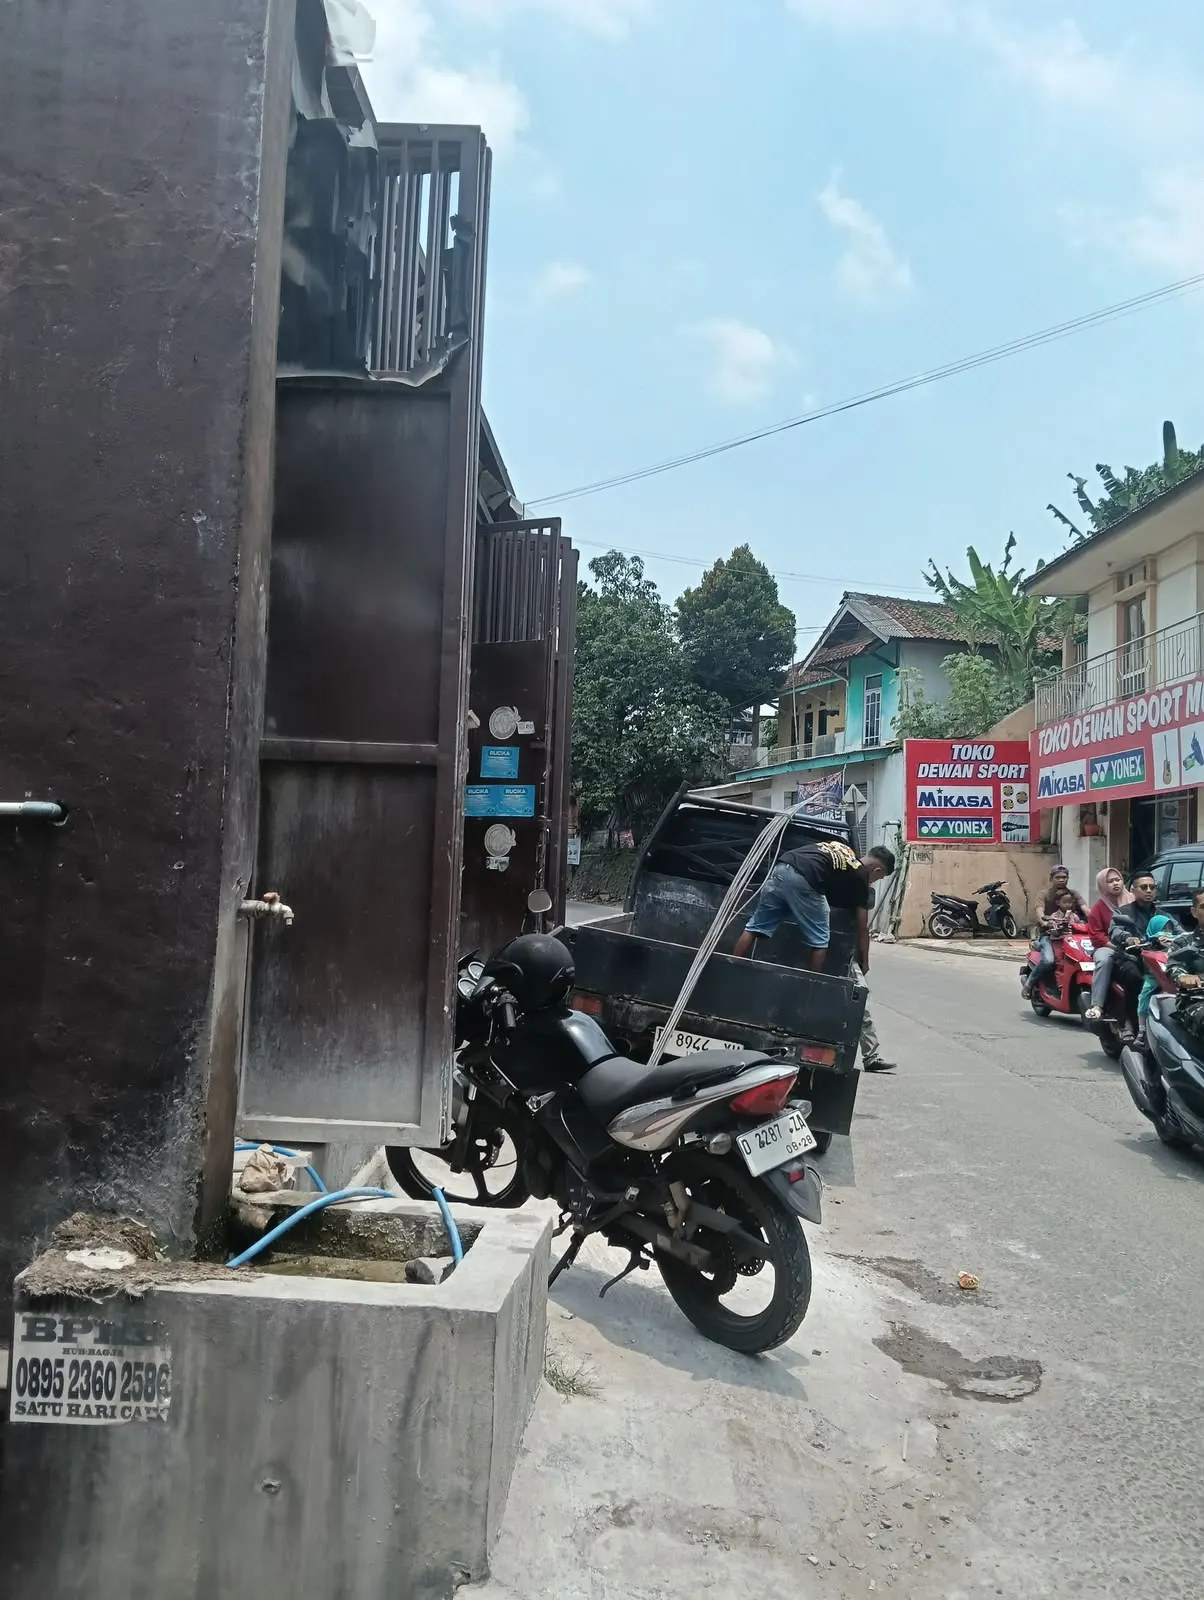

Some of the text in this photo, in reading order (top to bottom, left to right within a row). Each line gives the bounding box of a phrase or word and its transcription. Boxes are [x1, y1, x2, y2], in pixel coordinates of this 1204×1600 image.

[1038, 723, 1069, 757] TOKO
[1072, 705, 1125, 748] DEWAN
[1127, 686, 1183, 734] SPORT
[951, 744, 995, 761] TOKO
[917, 763, 1029, 779] DEWAN SPORT
[1111, 755, 1142, 780] YONEX
[947, 821, 988, 834] YONEX
[741, 1114, 806, 1155] D 2287 ZA
[21, 1316, 160, 1346] BP
[15, 1357, 65, 1398] 0895
[68, 1359, 117, 1401] 2360
[15, 1401, 63, 1416] SATU
[66, 1403, 117, 1419] HARI
